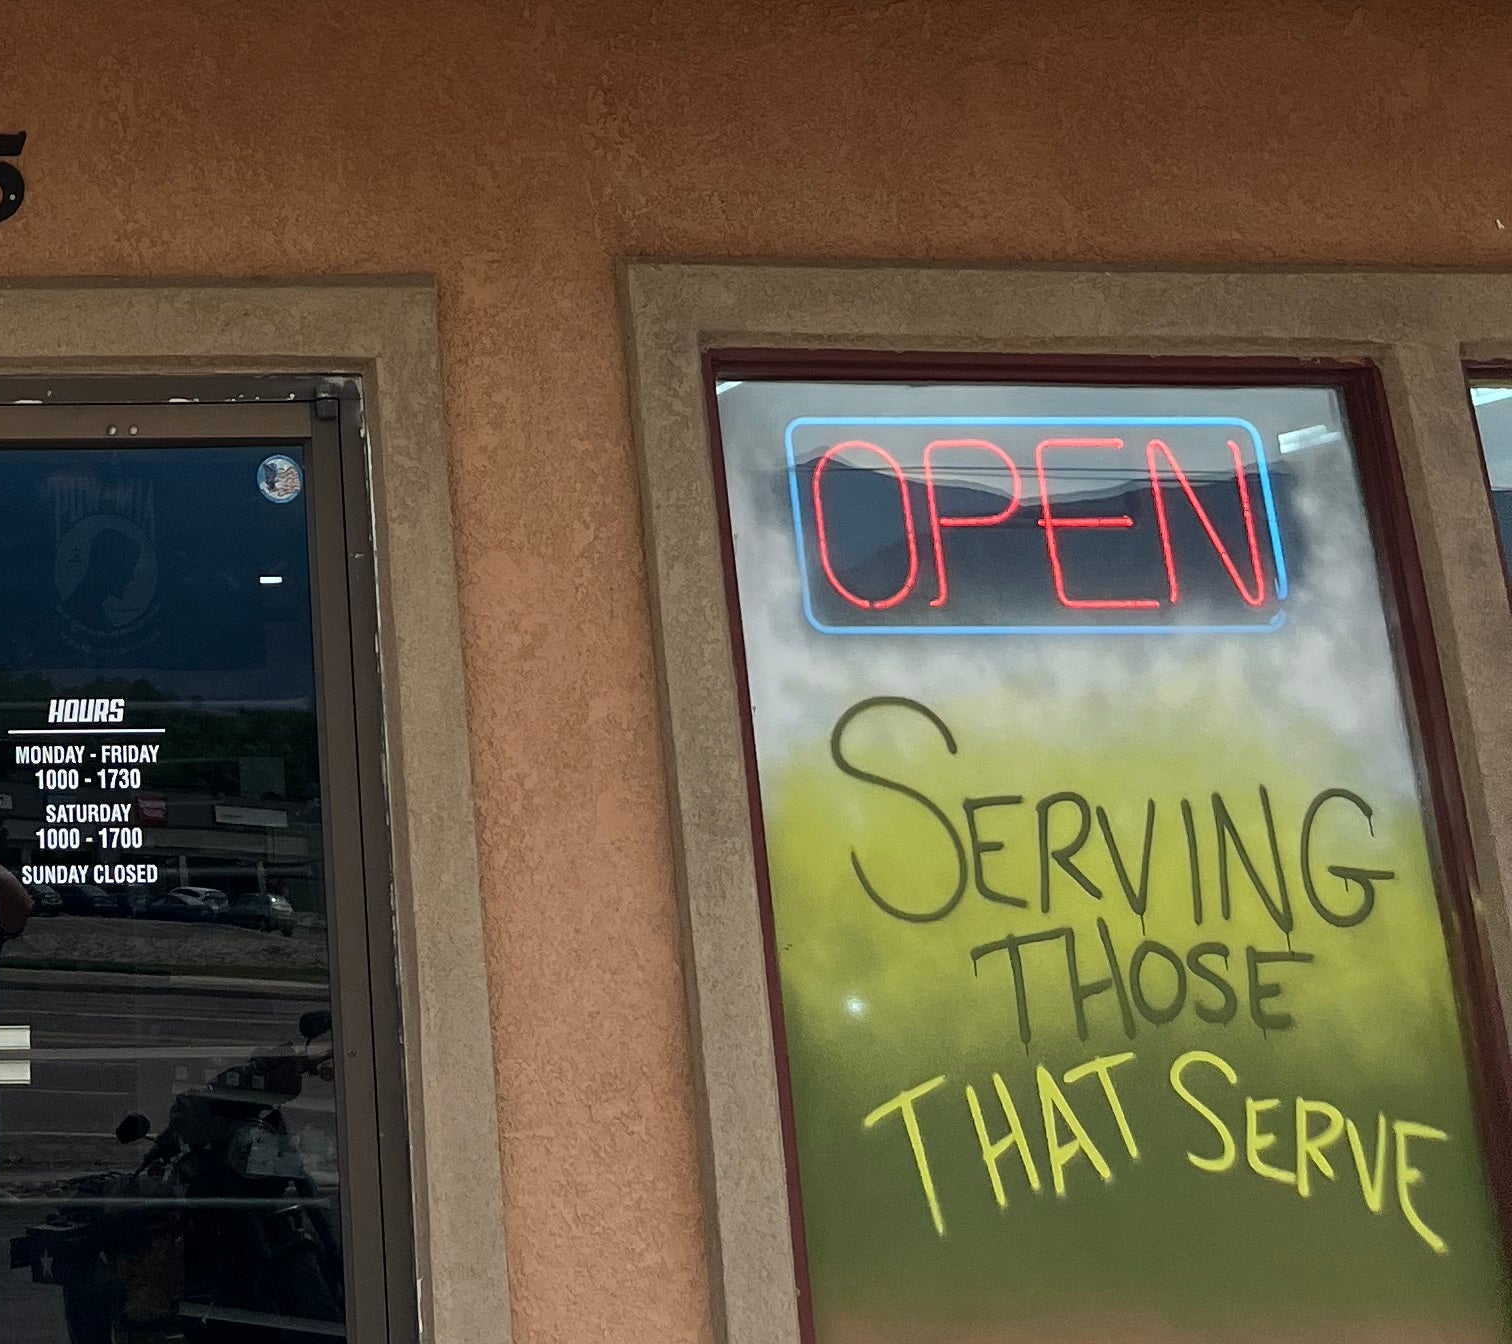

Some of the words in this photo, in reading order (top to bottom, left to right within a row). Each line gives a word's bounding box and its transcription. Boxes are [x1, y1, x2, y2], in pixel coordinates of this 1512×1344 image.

[811, 436, 1267, 611] OPEN
[47, 698, 125, 724] HOURS
[15, 745, 86, 765] MONDAY
[101, 744, 160, 764] FRIDAY
[35, 768, 80, 790] 1000
[97, 768, 141, 790] 1730
[45, 803, 132, 823] SATURDAY
[829, 695, 1396, 934] SERVING
[36, 828, 81, 850] 1000
[98, 827, 143, 849] 1700
[21, 865, 89, 884] SUNDAY
[93, 864, 159, 884] CLOSED
[972, 920, 1315, 1048] THOSE
[863, 1050, 1147, 1236] THAT
[1168, 1049, 1449, 1255] SERVE
